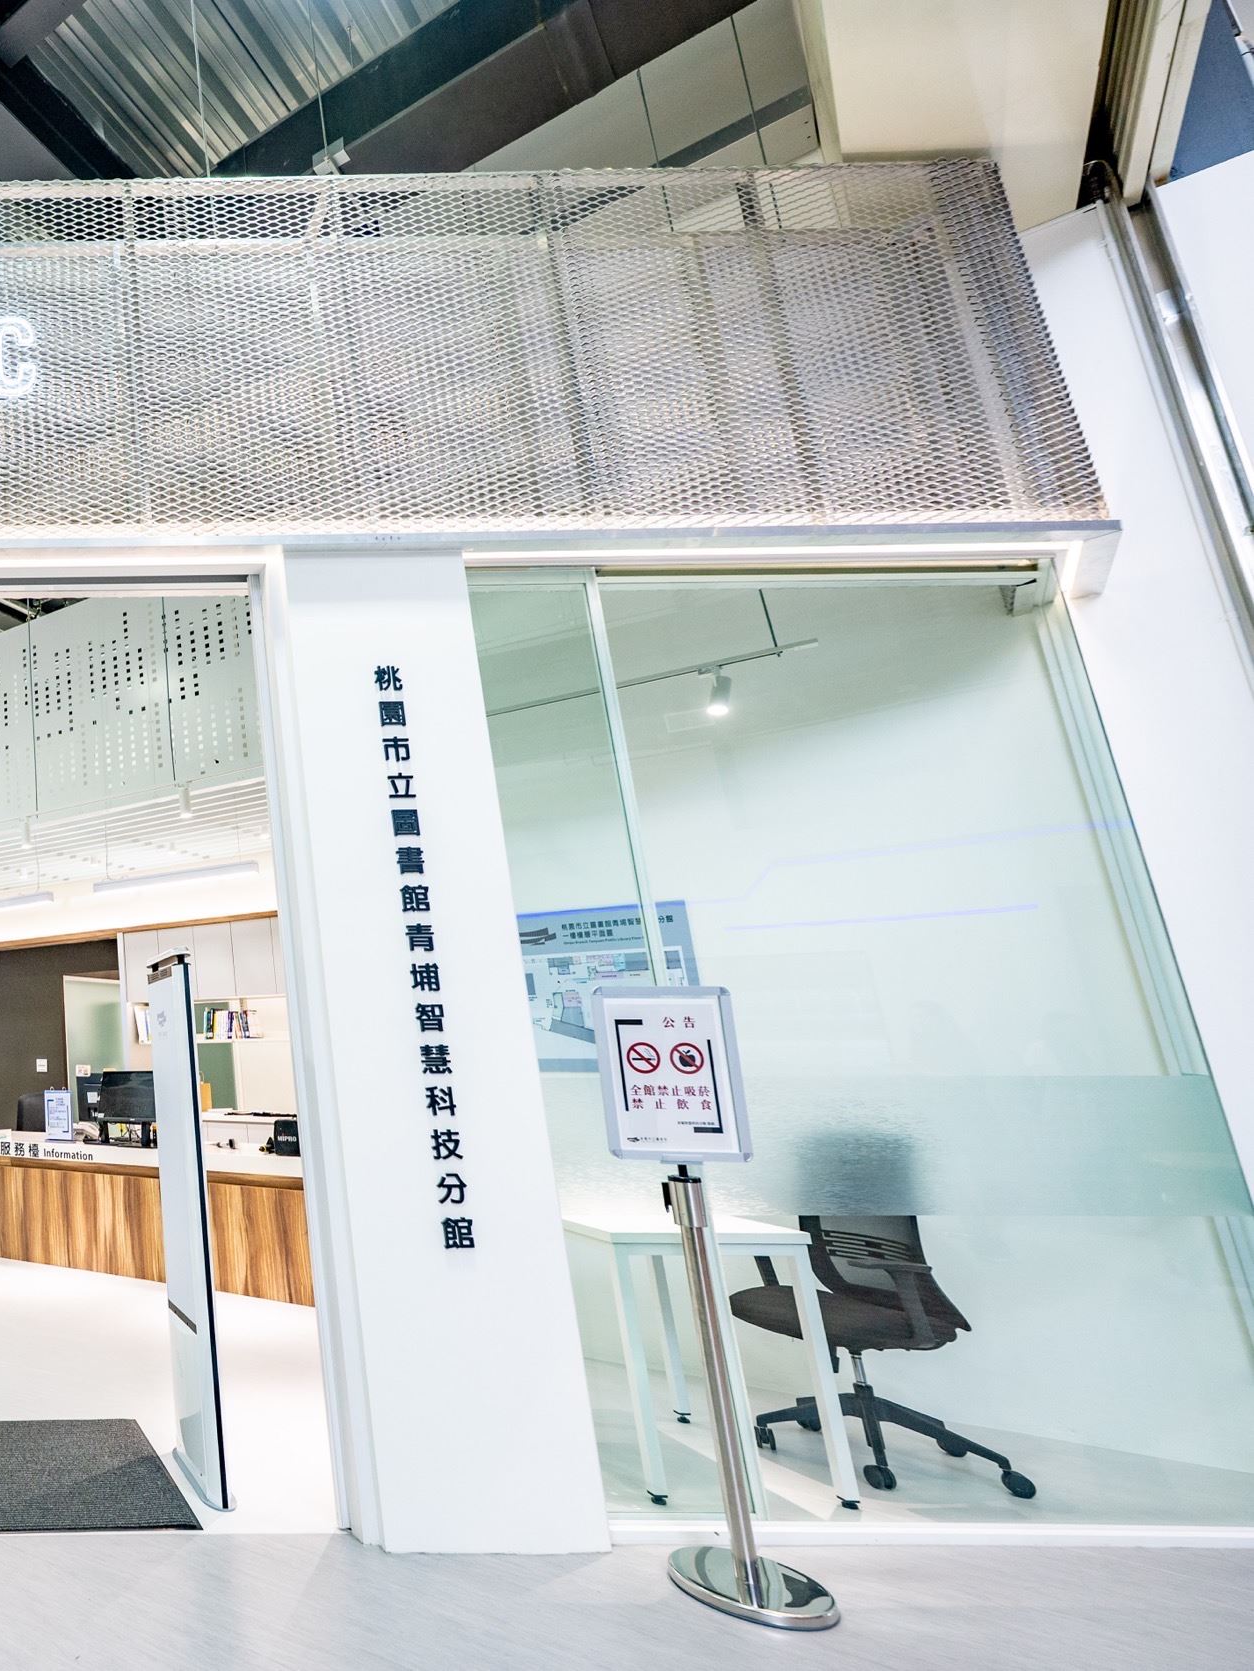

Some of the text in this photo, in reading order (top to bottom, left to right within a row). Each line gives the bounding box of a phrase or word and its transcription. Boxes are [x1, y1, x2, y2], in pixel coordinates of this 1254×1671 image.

[374, 665, 475, 1250] 桃園市立圖書館青埔智慧科技分館
[662, 1016, 695, 1028] 公告
[630, 1084, 710, 1097] 全館禁止吸菸
[632, 1098, 712, 1111] 禁止飲食
[44, 1149, 94, 1161] Information
